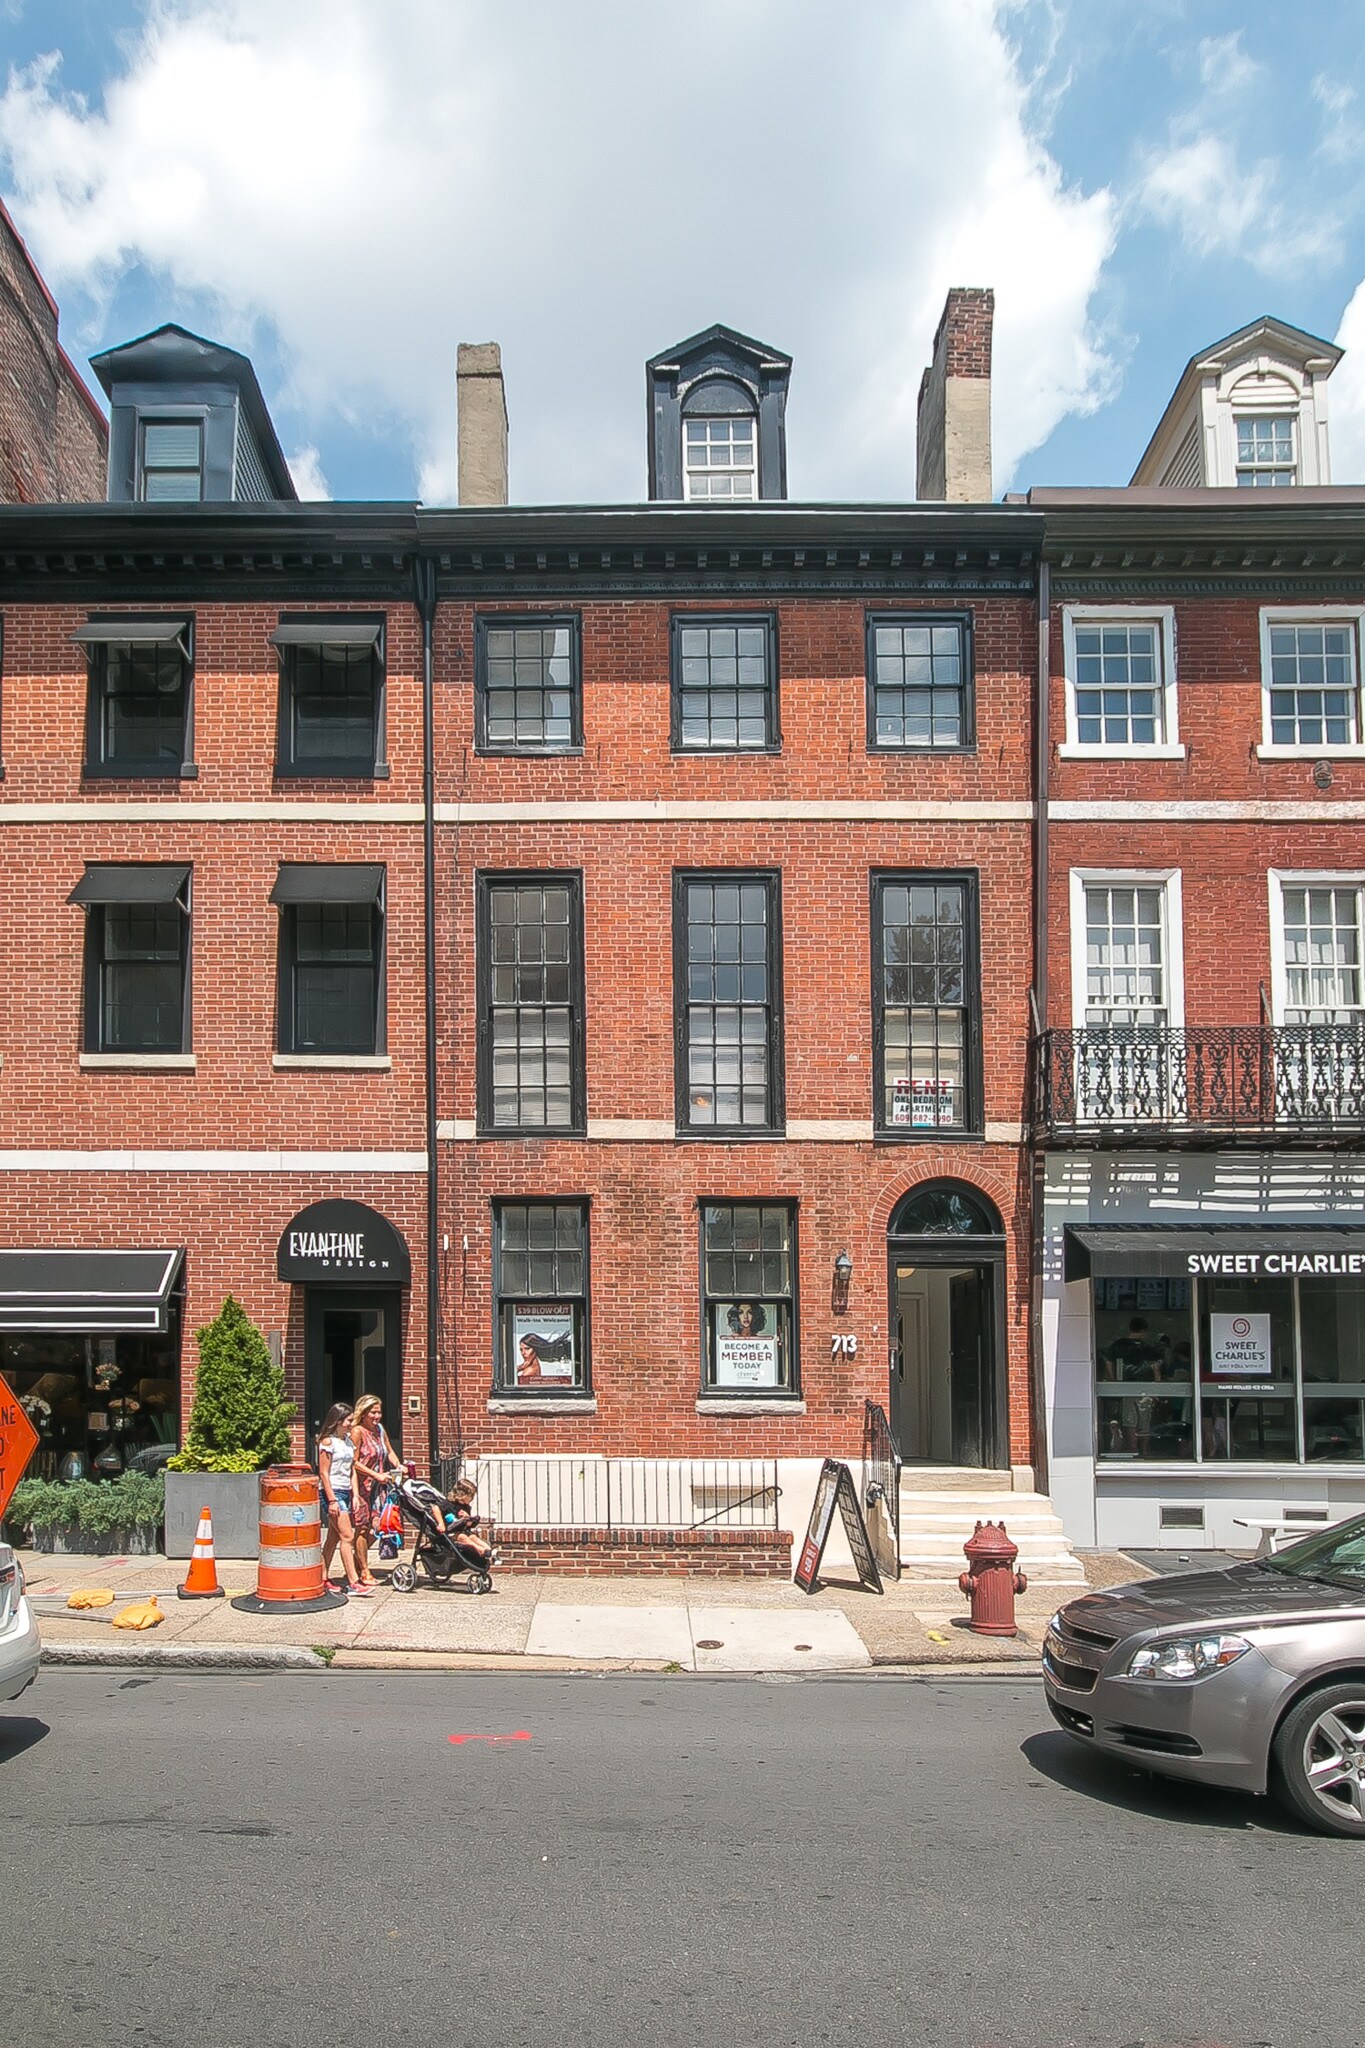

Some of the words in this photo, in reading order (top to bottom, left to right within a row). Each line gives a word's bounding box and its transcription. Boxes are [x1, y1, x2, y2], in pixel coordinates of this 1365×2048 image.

[897, 1080, 949, 1094] RENT
[913, 1096, 952, 1104] BEDROOM
[895, 1114, 951, 1122] 609682-490
[289, 1231, 365, 1259] EVANTINE
[322, 1259, 389, 1268] DESIGN
[1187, 1254, 1260, 1273] SWEET
[553, 1305, 569, 1314] OUT
[831, 1334, 858, 1353] 713
[1225, 1341, 1258, 1351] SWEET
[721, 1351, 773, 1361] MEMBER
[732, 1362, 762, 1370] TODAY
